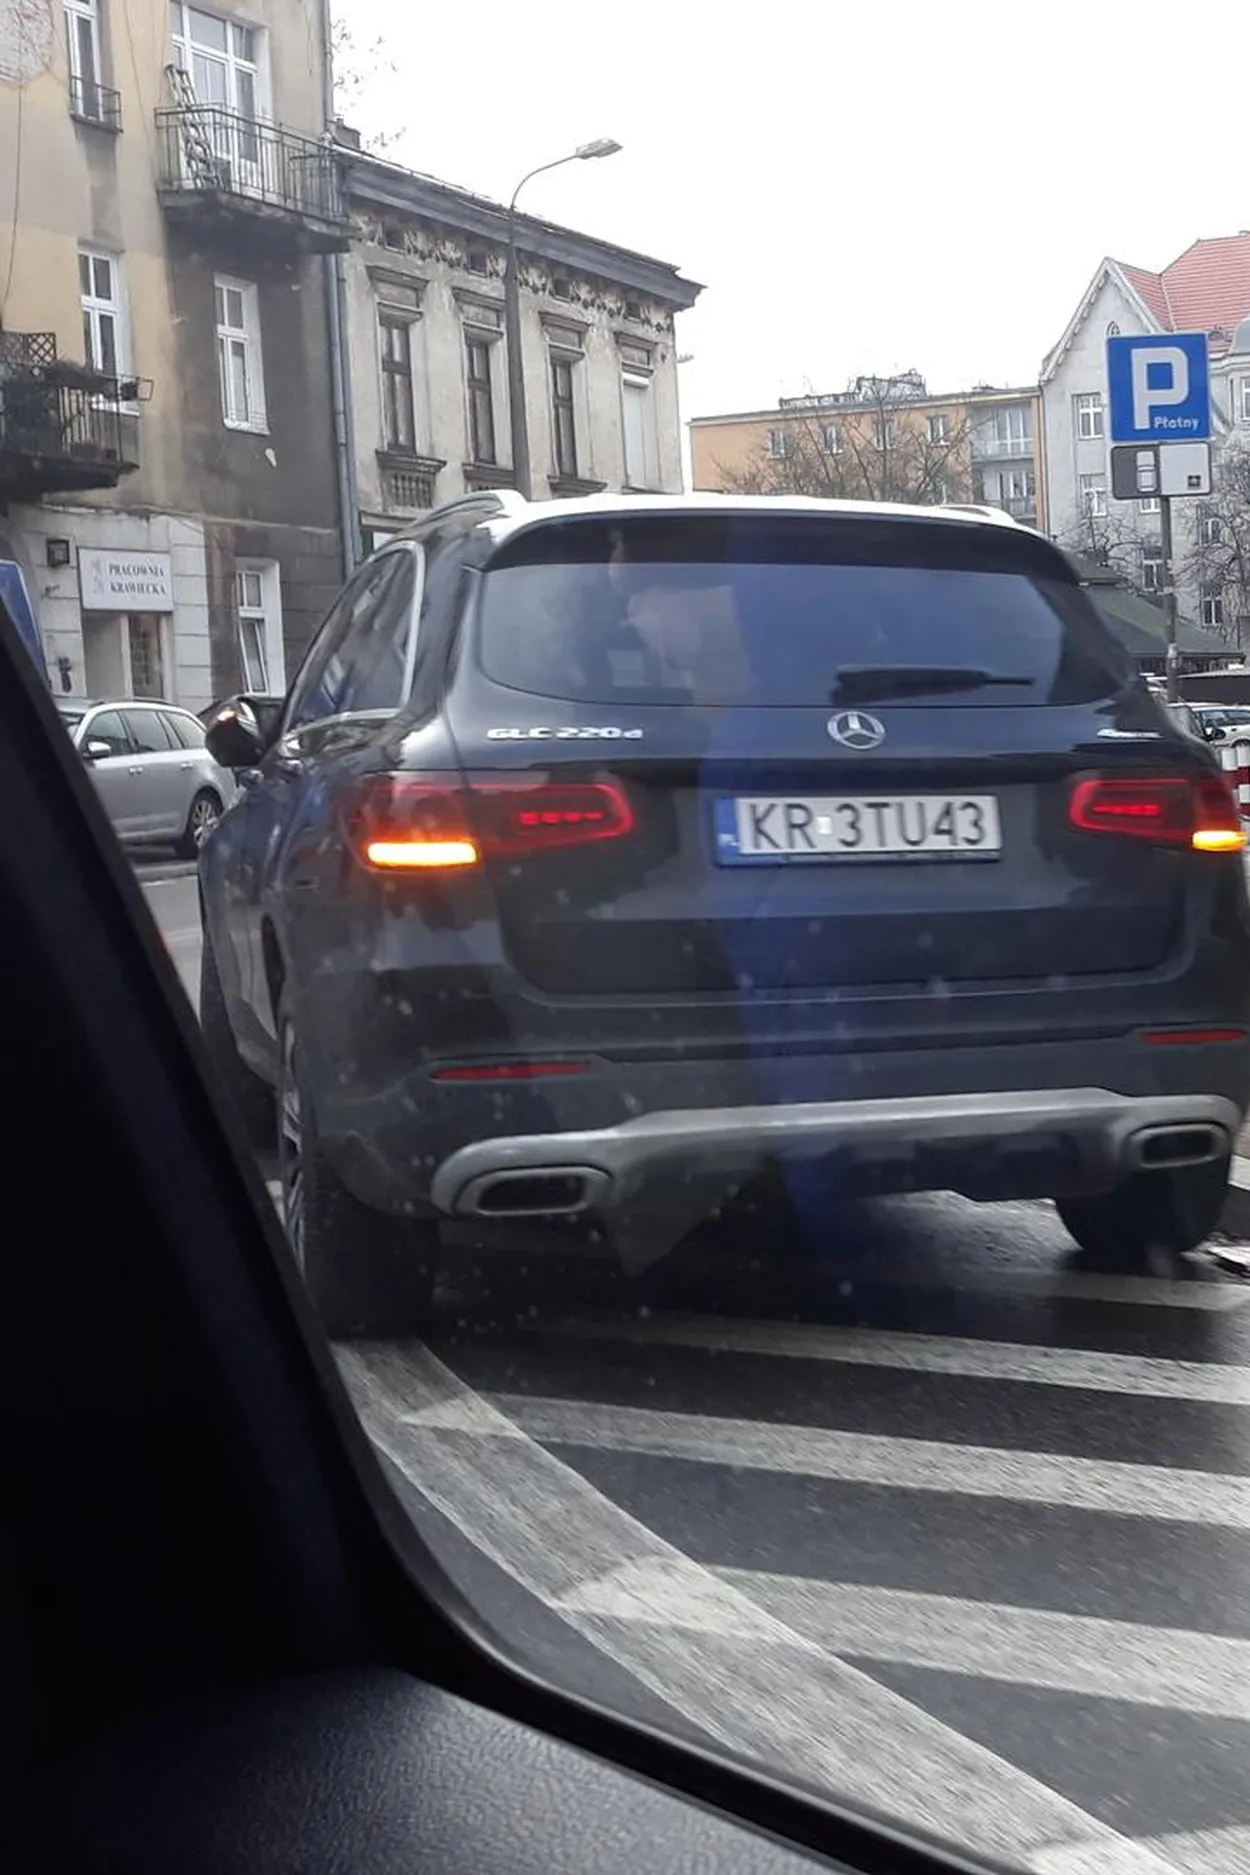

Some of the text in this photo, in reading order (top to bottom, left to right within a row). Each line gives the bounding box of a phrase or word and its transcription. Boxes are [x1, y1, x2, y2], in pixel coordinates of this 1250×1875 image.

[1131, 347, 1188, 429] P
[1153, 416, 1200, 431] Płatny
[108, 563, 165, 577] PRACOWNIA
[110, 582, 167, 595] KRAWIECKA
[487, 726, 552, 740] GLC
[751, 801, 985, 849] KR 3TU43
